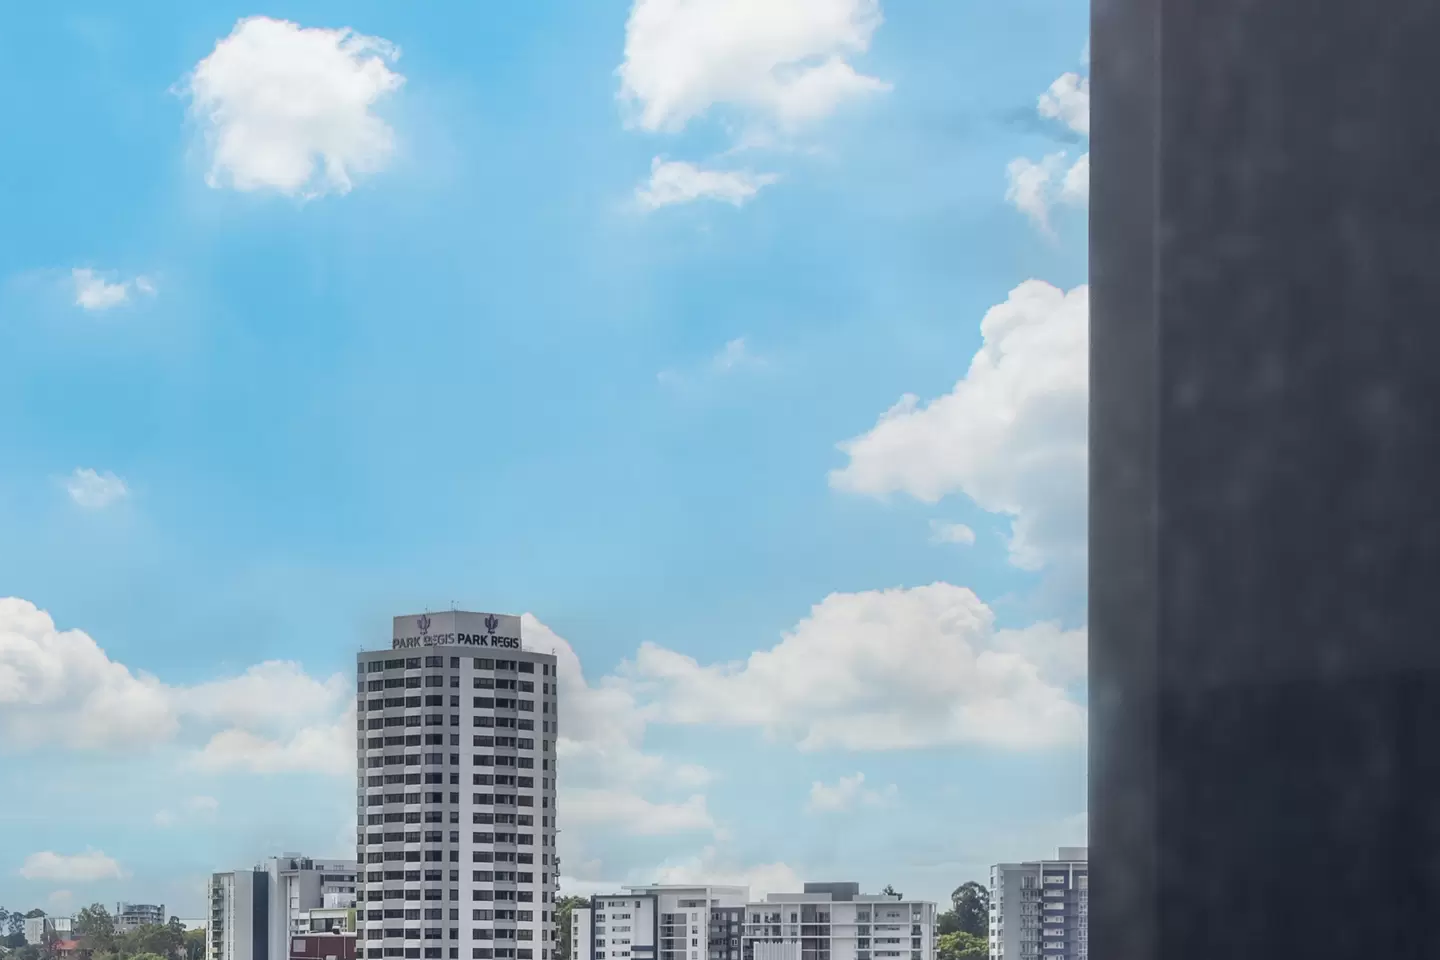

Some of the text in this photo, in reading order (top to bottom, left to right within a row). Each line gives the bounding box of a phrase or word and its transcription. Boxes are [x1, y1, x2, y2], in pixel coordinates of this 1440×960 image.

[393, 637, 420, 649] PARK
[457, 633, 520, 649] PARK REGIS
